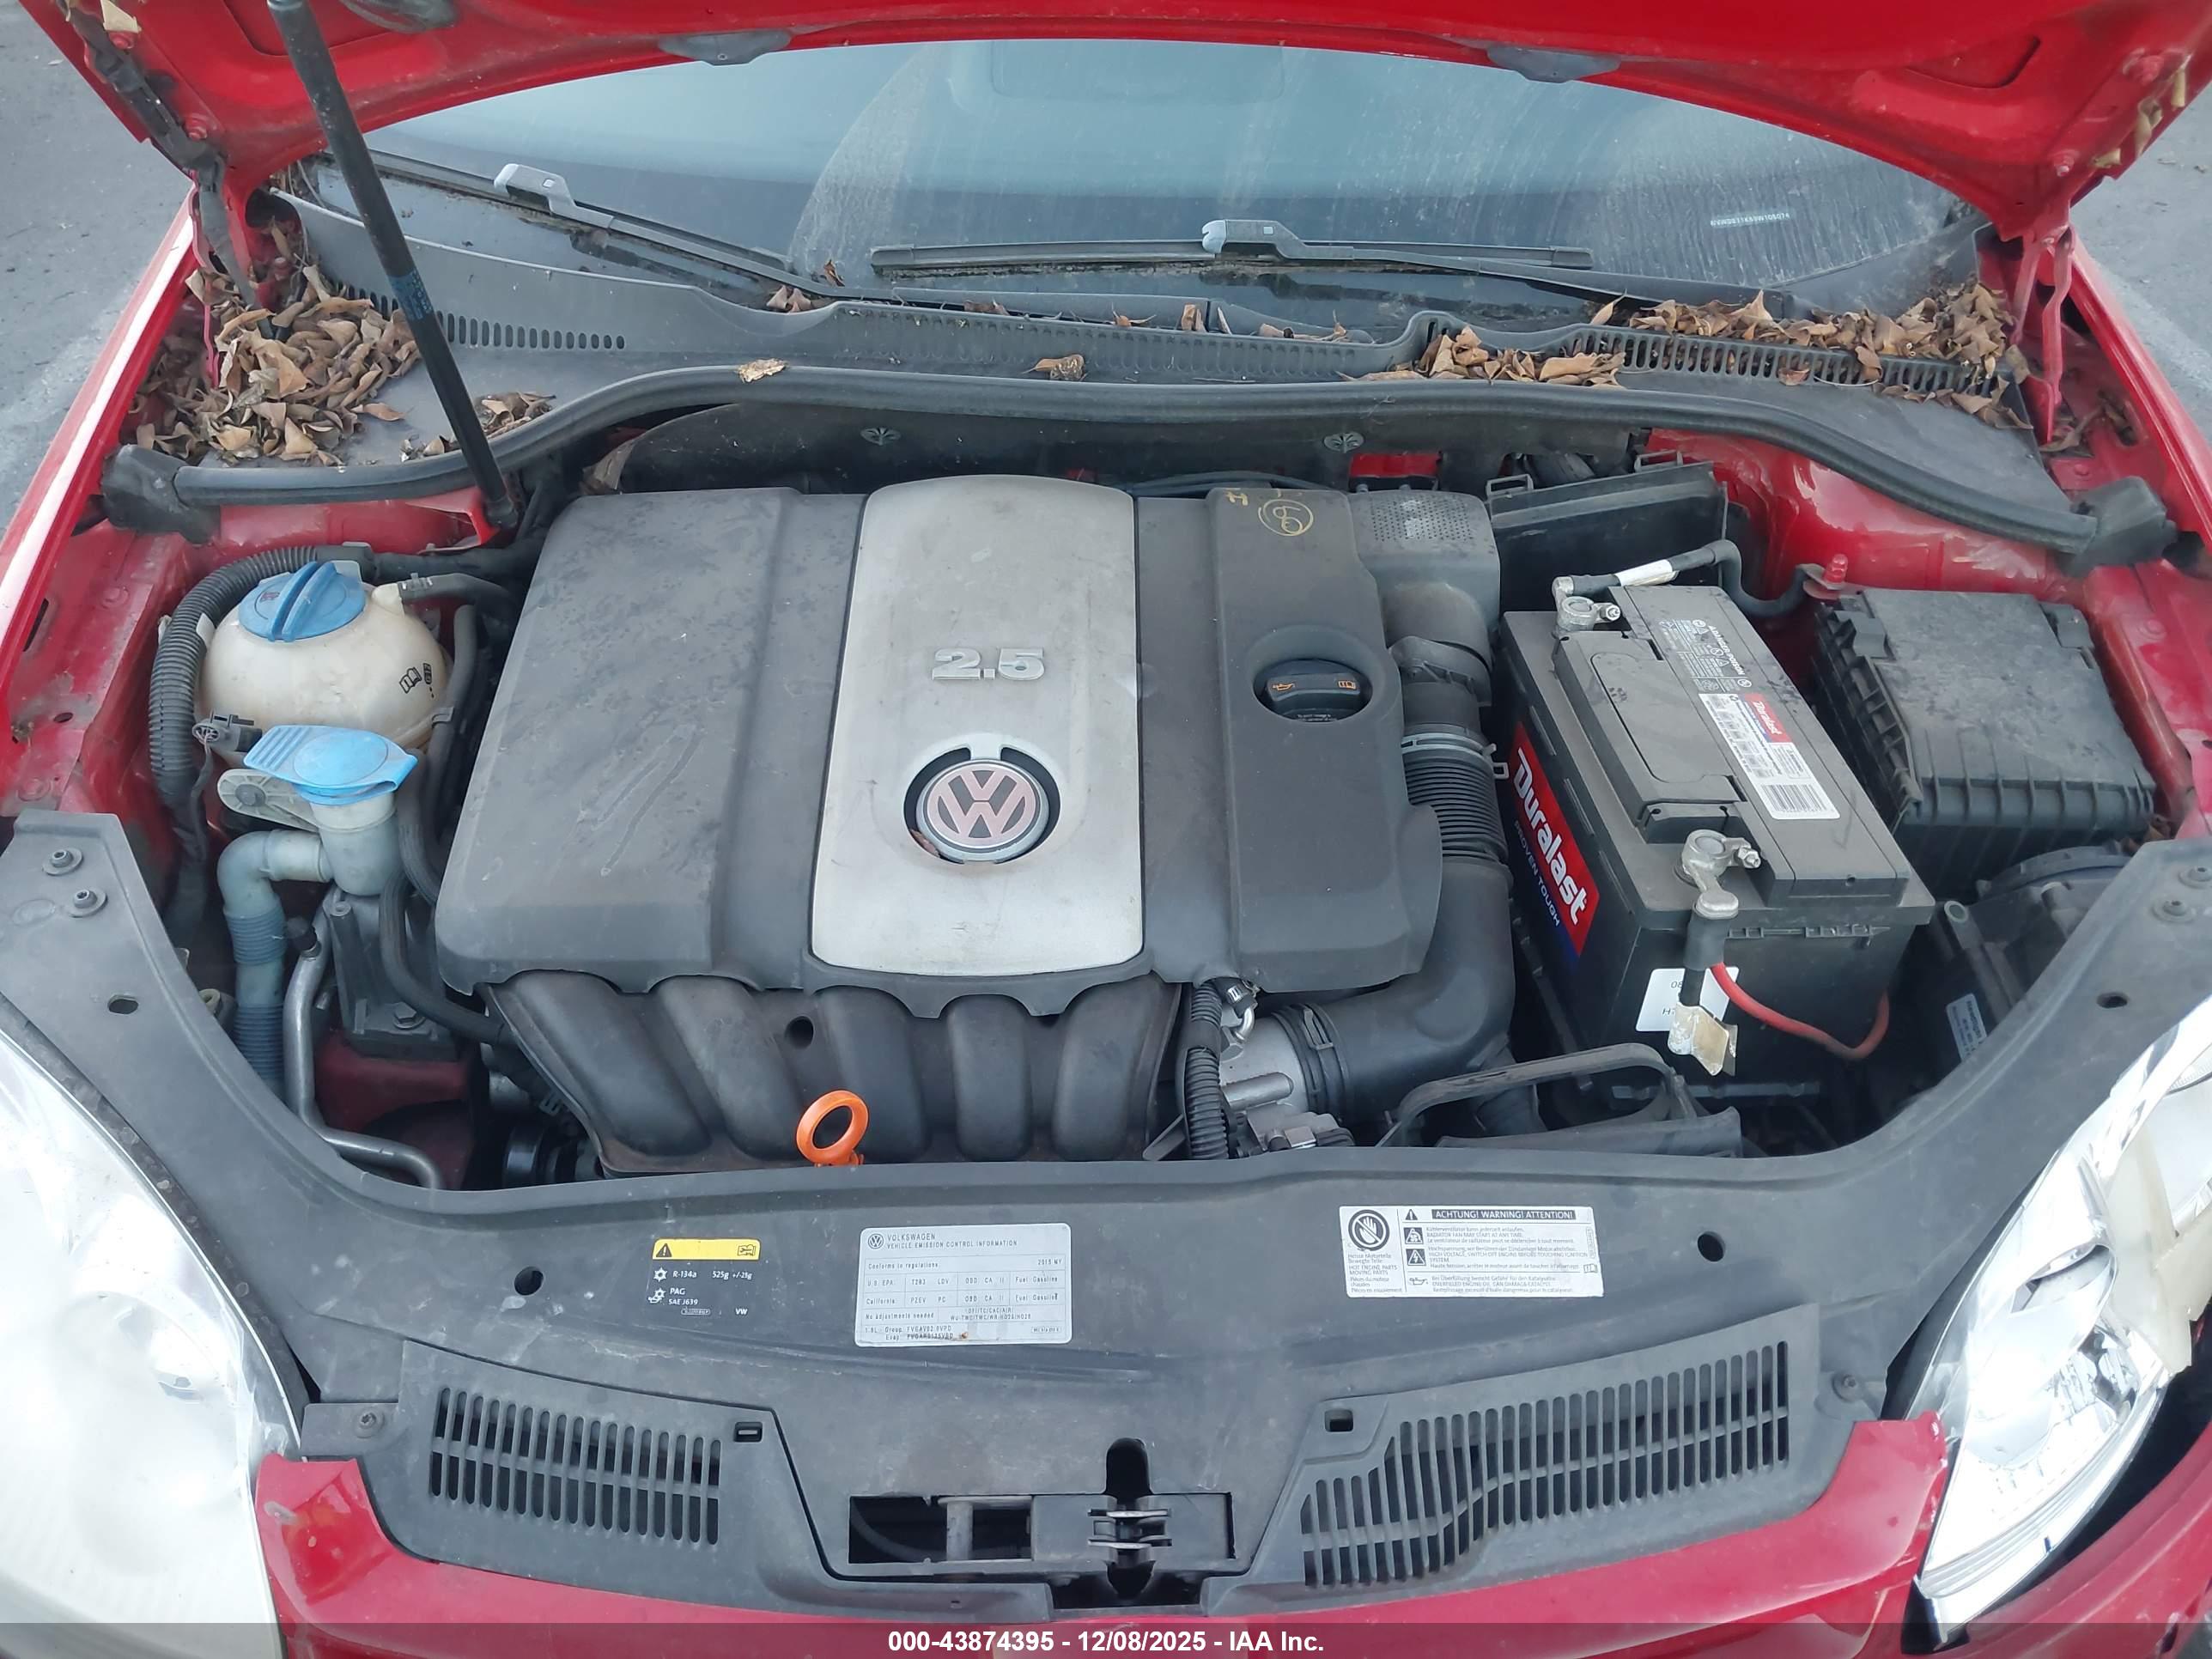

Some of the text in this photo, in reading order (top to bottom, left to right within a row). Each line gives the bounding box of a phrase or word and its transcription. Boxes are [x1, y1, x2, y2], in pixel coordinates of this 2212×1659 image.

[932, 647, 1045, 681] 2.5
[1513, 746, 1588, 926] Duralast
[1514, 820, 1561, 927] PROVEN TOUGH
[1435, 1210, 1479, 1218] ACHTUNG!
[1525, 1211, 1573, 1219] ATTENTION!
[887, 1233, 935, 1242] VOLKSWAGEN
[712, 1271, 729, 1280] 525g
